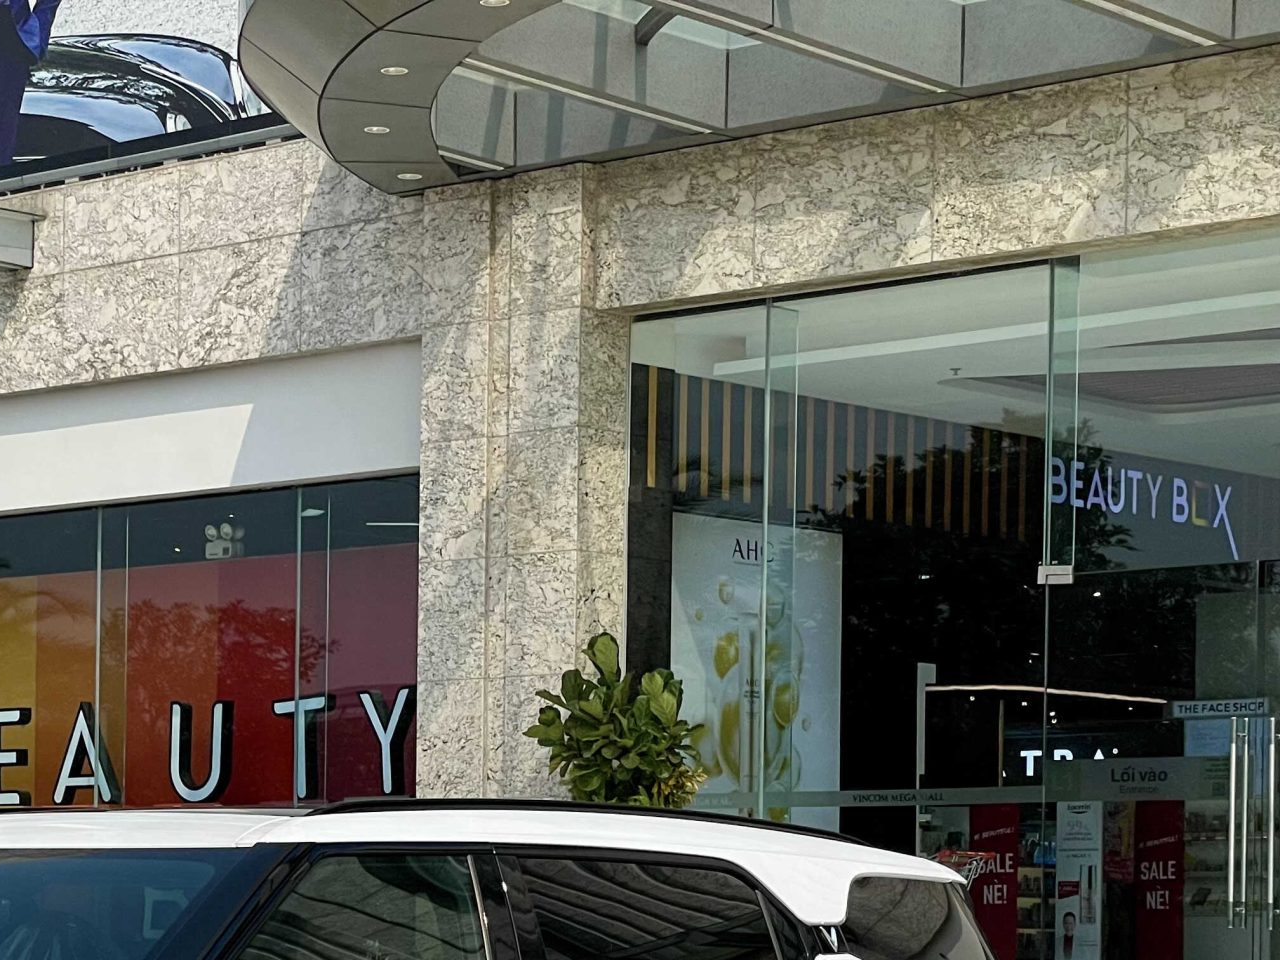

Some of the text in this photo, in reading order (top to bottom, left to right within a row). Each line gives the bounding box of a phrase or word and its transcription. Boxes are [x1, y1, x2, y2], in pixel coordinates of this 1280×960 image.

[1051, 457, 1163, 519] BEAUTY
[1178, 701, 1265, 714] THE FACE SHOP
[1111, 764, 1168, 783] Lối vào
[852, 793, 890, 803] VINCOM
[891, 793, 918, 802] MEGA
[1140, 860, 1176, 880] SALE
[983, 880, 1008, 904] NÈ!
[1146, 886, 1170, 910] NÈ!
